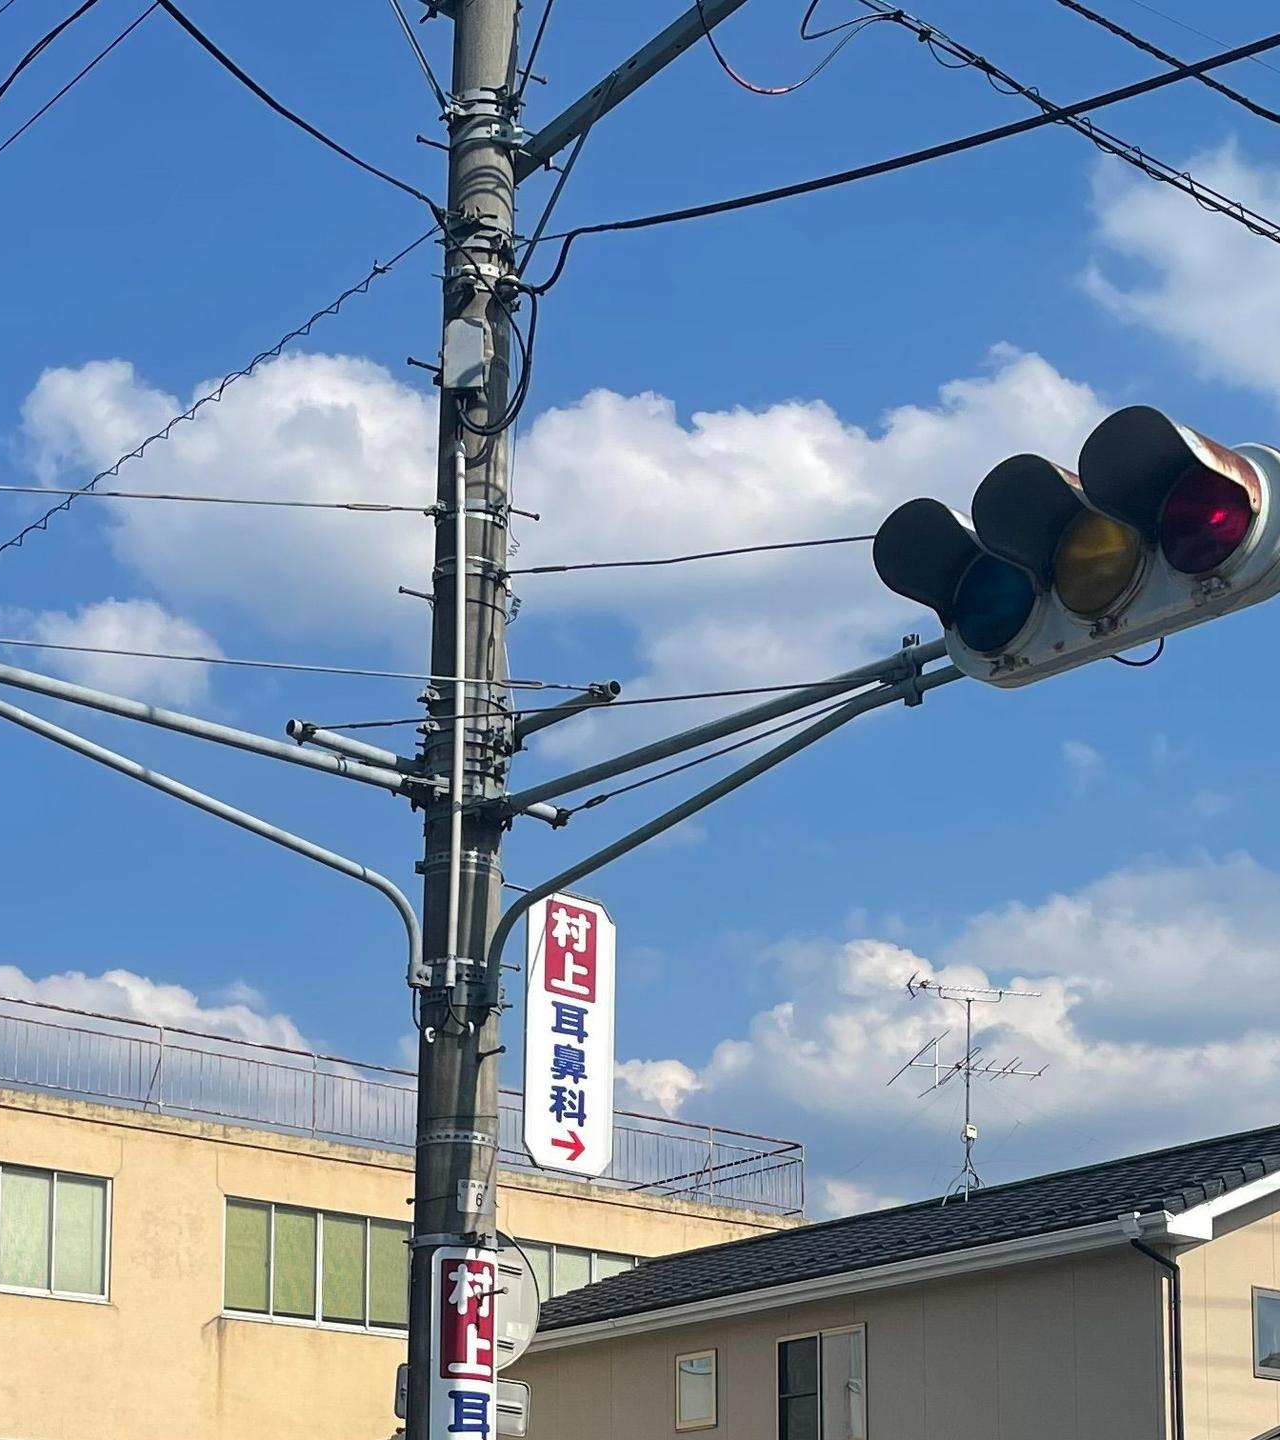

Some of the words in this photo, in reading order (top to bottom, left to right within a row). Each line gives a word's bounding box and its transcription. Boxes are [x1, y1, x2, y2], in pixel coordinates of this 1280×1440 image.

[549, 907, 591, 1127] 村上耳鼻科
